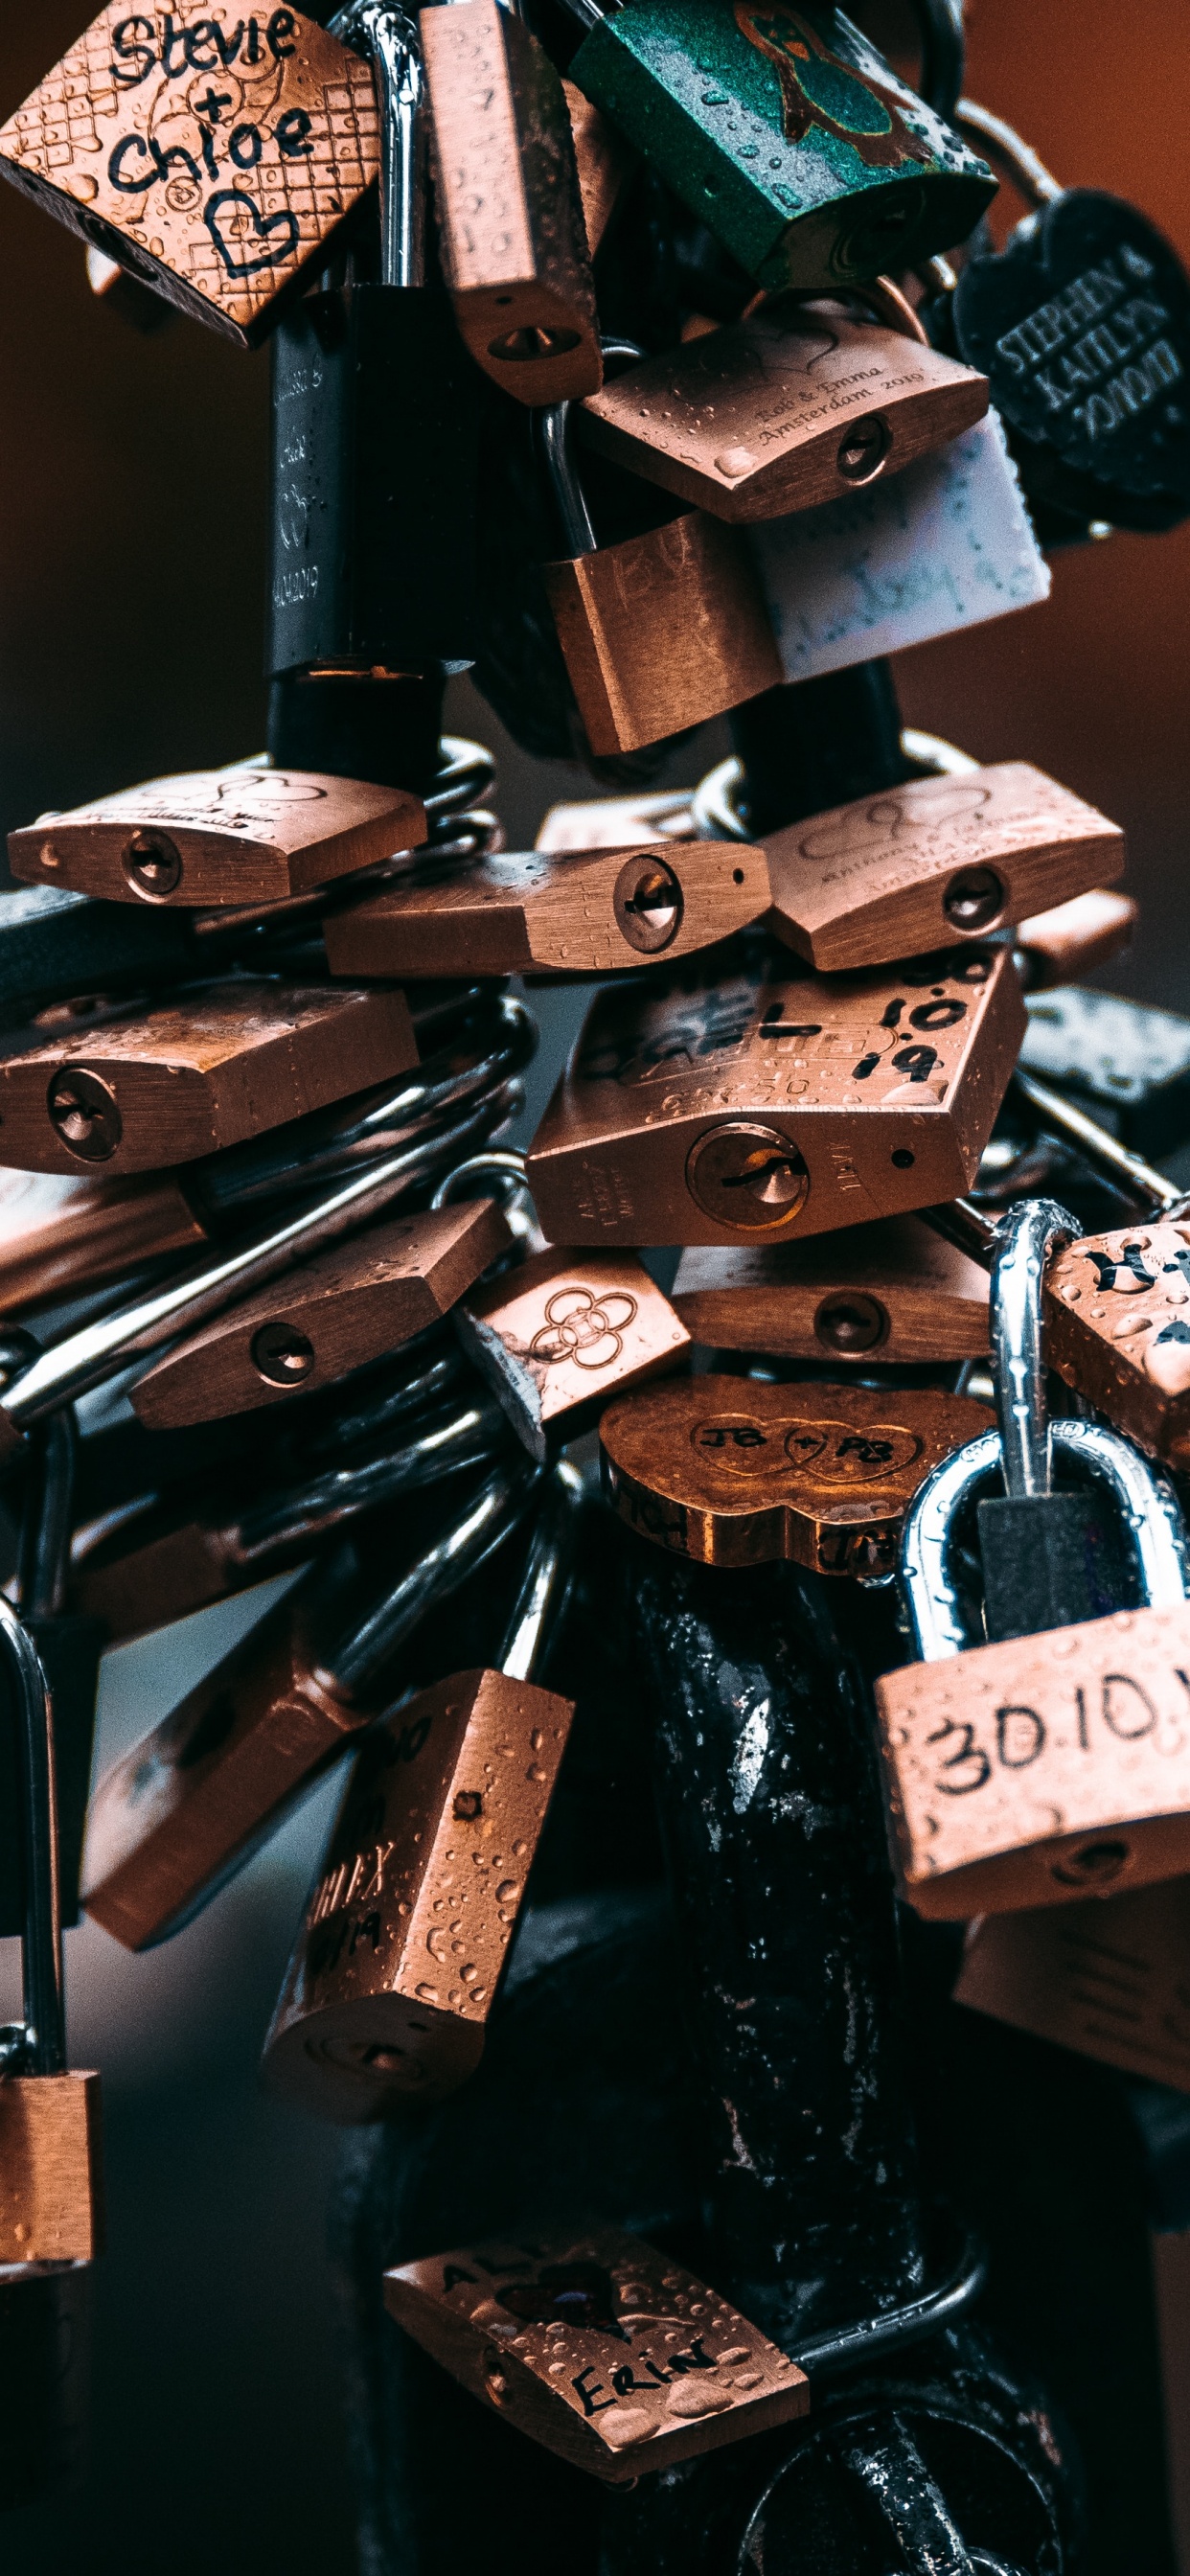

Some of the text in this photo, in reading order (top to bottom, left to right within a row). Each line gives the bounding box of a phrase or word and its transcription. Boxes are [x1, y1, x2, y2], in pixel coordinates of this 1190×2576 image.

[110, 6, 297, 84] Stevie
[194, 86, 234, 126] +
[107, 106, 315, 193] Chloe
[996, 257, 1127, 376] STEPHEN
[1033, 298, 1171, 411] KAITLYN
[759, 368, 926, 448] Amsterdam 2019
[816, 366, 884, 394] Emma
